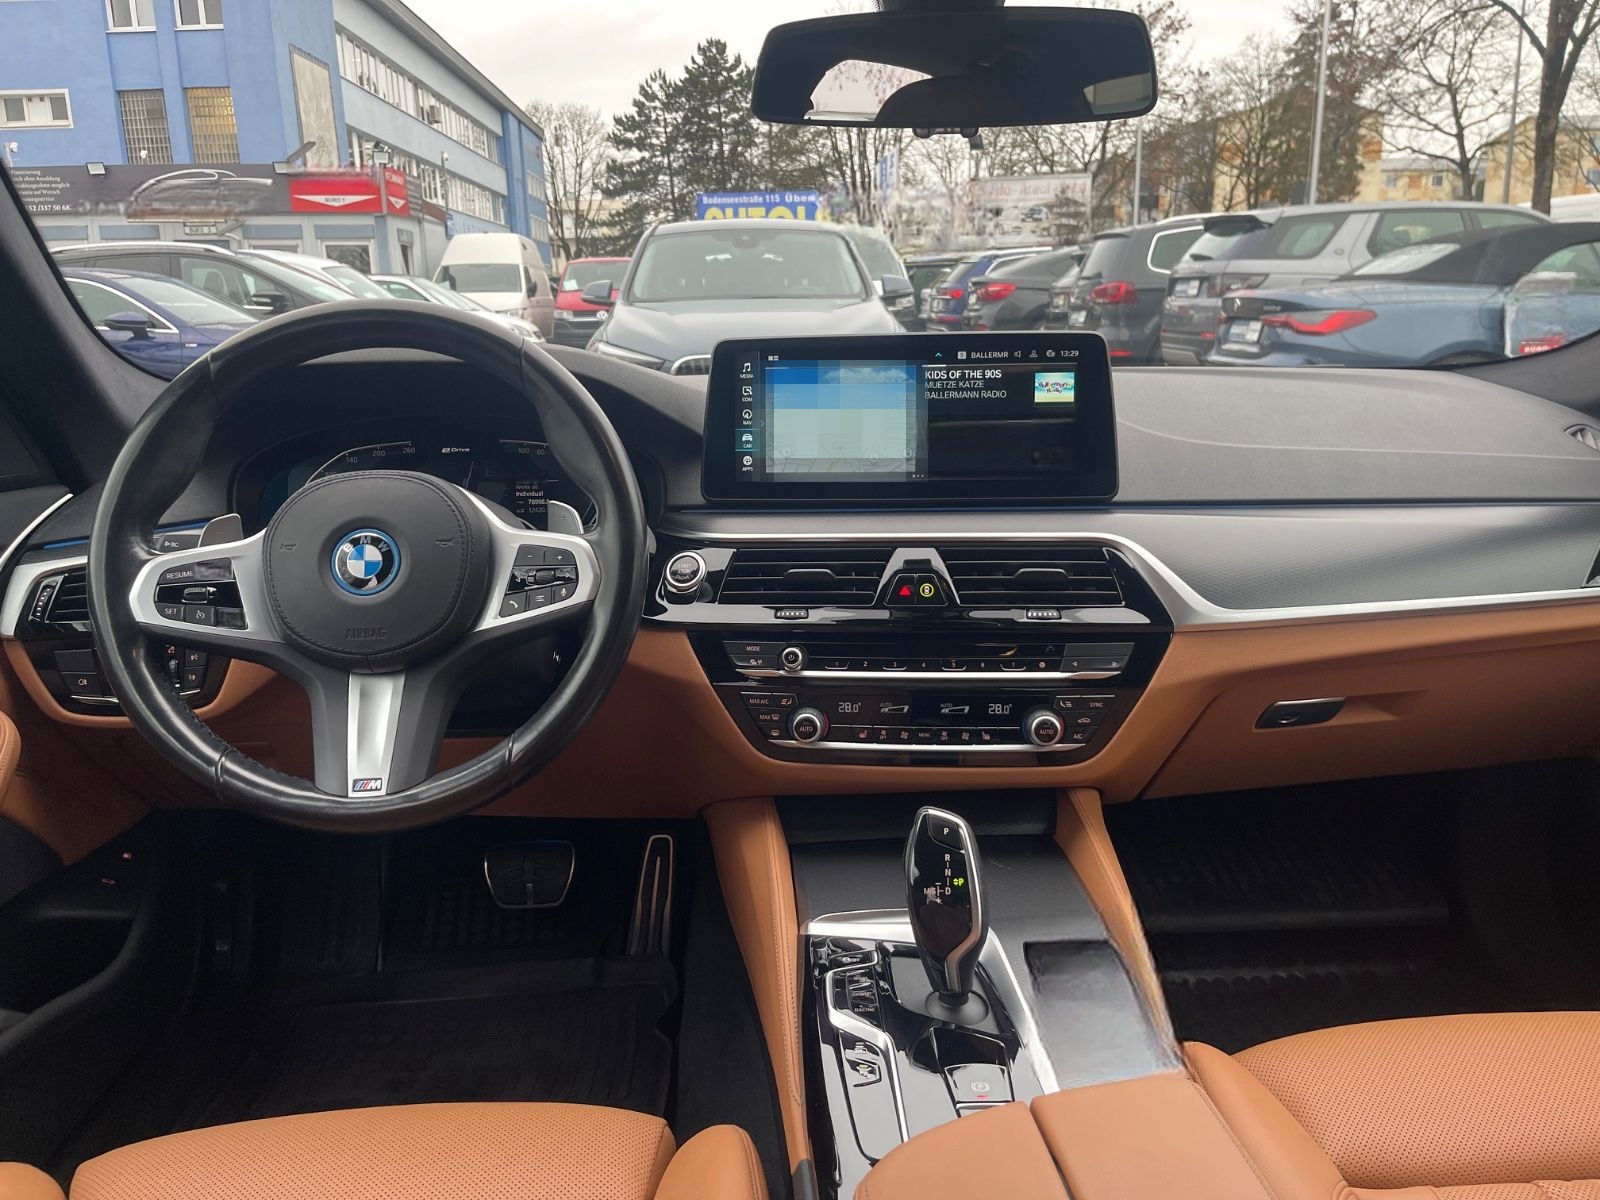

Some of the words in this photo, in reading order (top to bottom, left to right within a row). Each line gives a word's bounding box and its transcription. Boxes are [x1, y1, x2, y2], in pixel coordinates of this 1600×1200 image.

[766, 194, 780, 203] 115
[925, 370, 947, 379] KIDS
[949, 370, 963, 379] OF
[964, 370, 983, 379] THE
[984, 369, 1002, 379] 90S
[958, 380, 984, 388] KATZE
[925, 391, 980, 399] BALLERMANN
[981, 390, 1007, 398] RADIO
[342, 535, 390, 554] BMW
[166, 571, 194, 579] RESUME
[345, 627, 388, 640] AIRBAG
[943, 827, 949, 835] P
[945, 887, 951, 895] D
